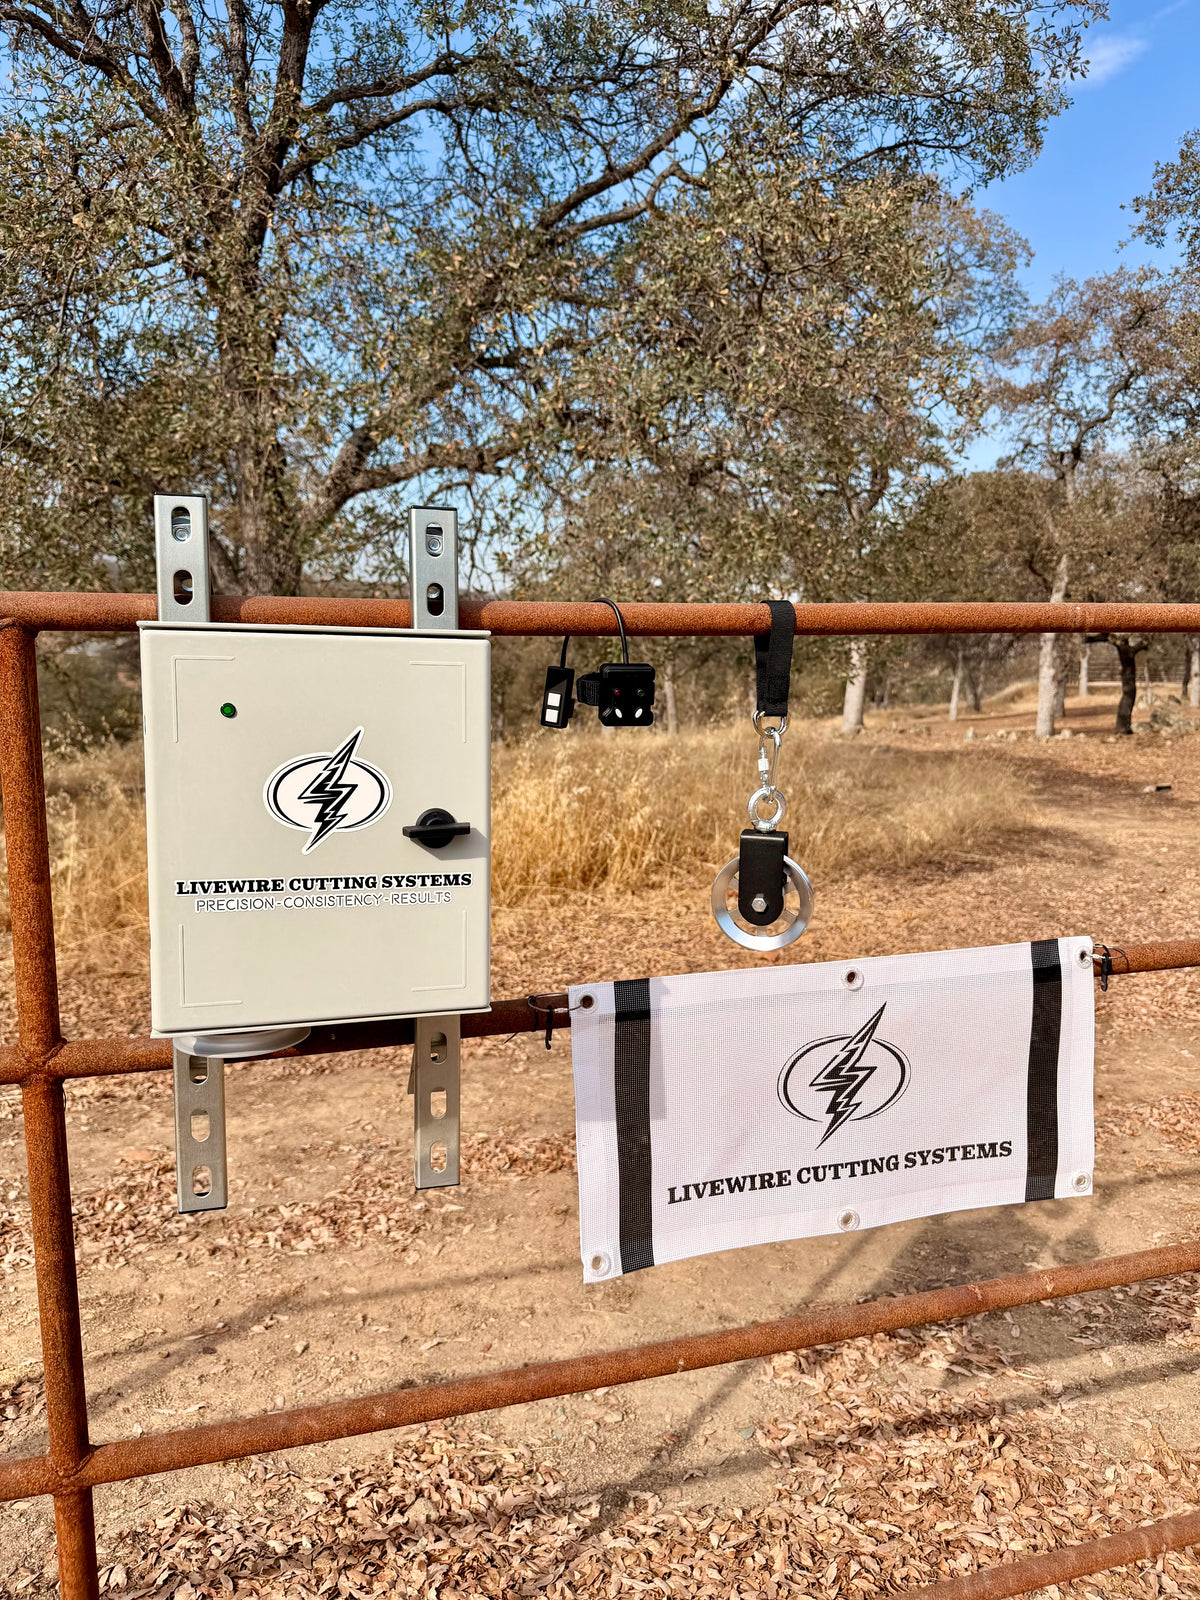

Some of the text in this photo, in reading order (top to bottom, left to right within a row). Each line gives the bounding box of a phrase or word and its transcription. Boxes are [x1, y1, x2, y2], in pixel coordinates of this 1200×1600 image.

[176, 873, 473, 895] LIVEWIRE CUTTING SYSTEMS
[667, 1140, 1013, 1205] LIVEWIRE CUTTING SYSTEMS
